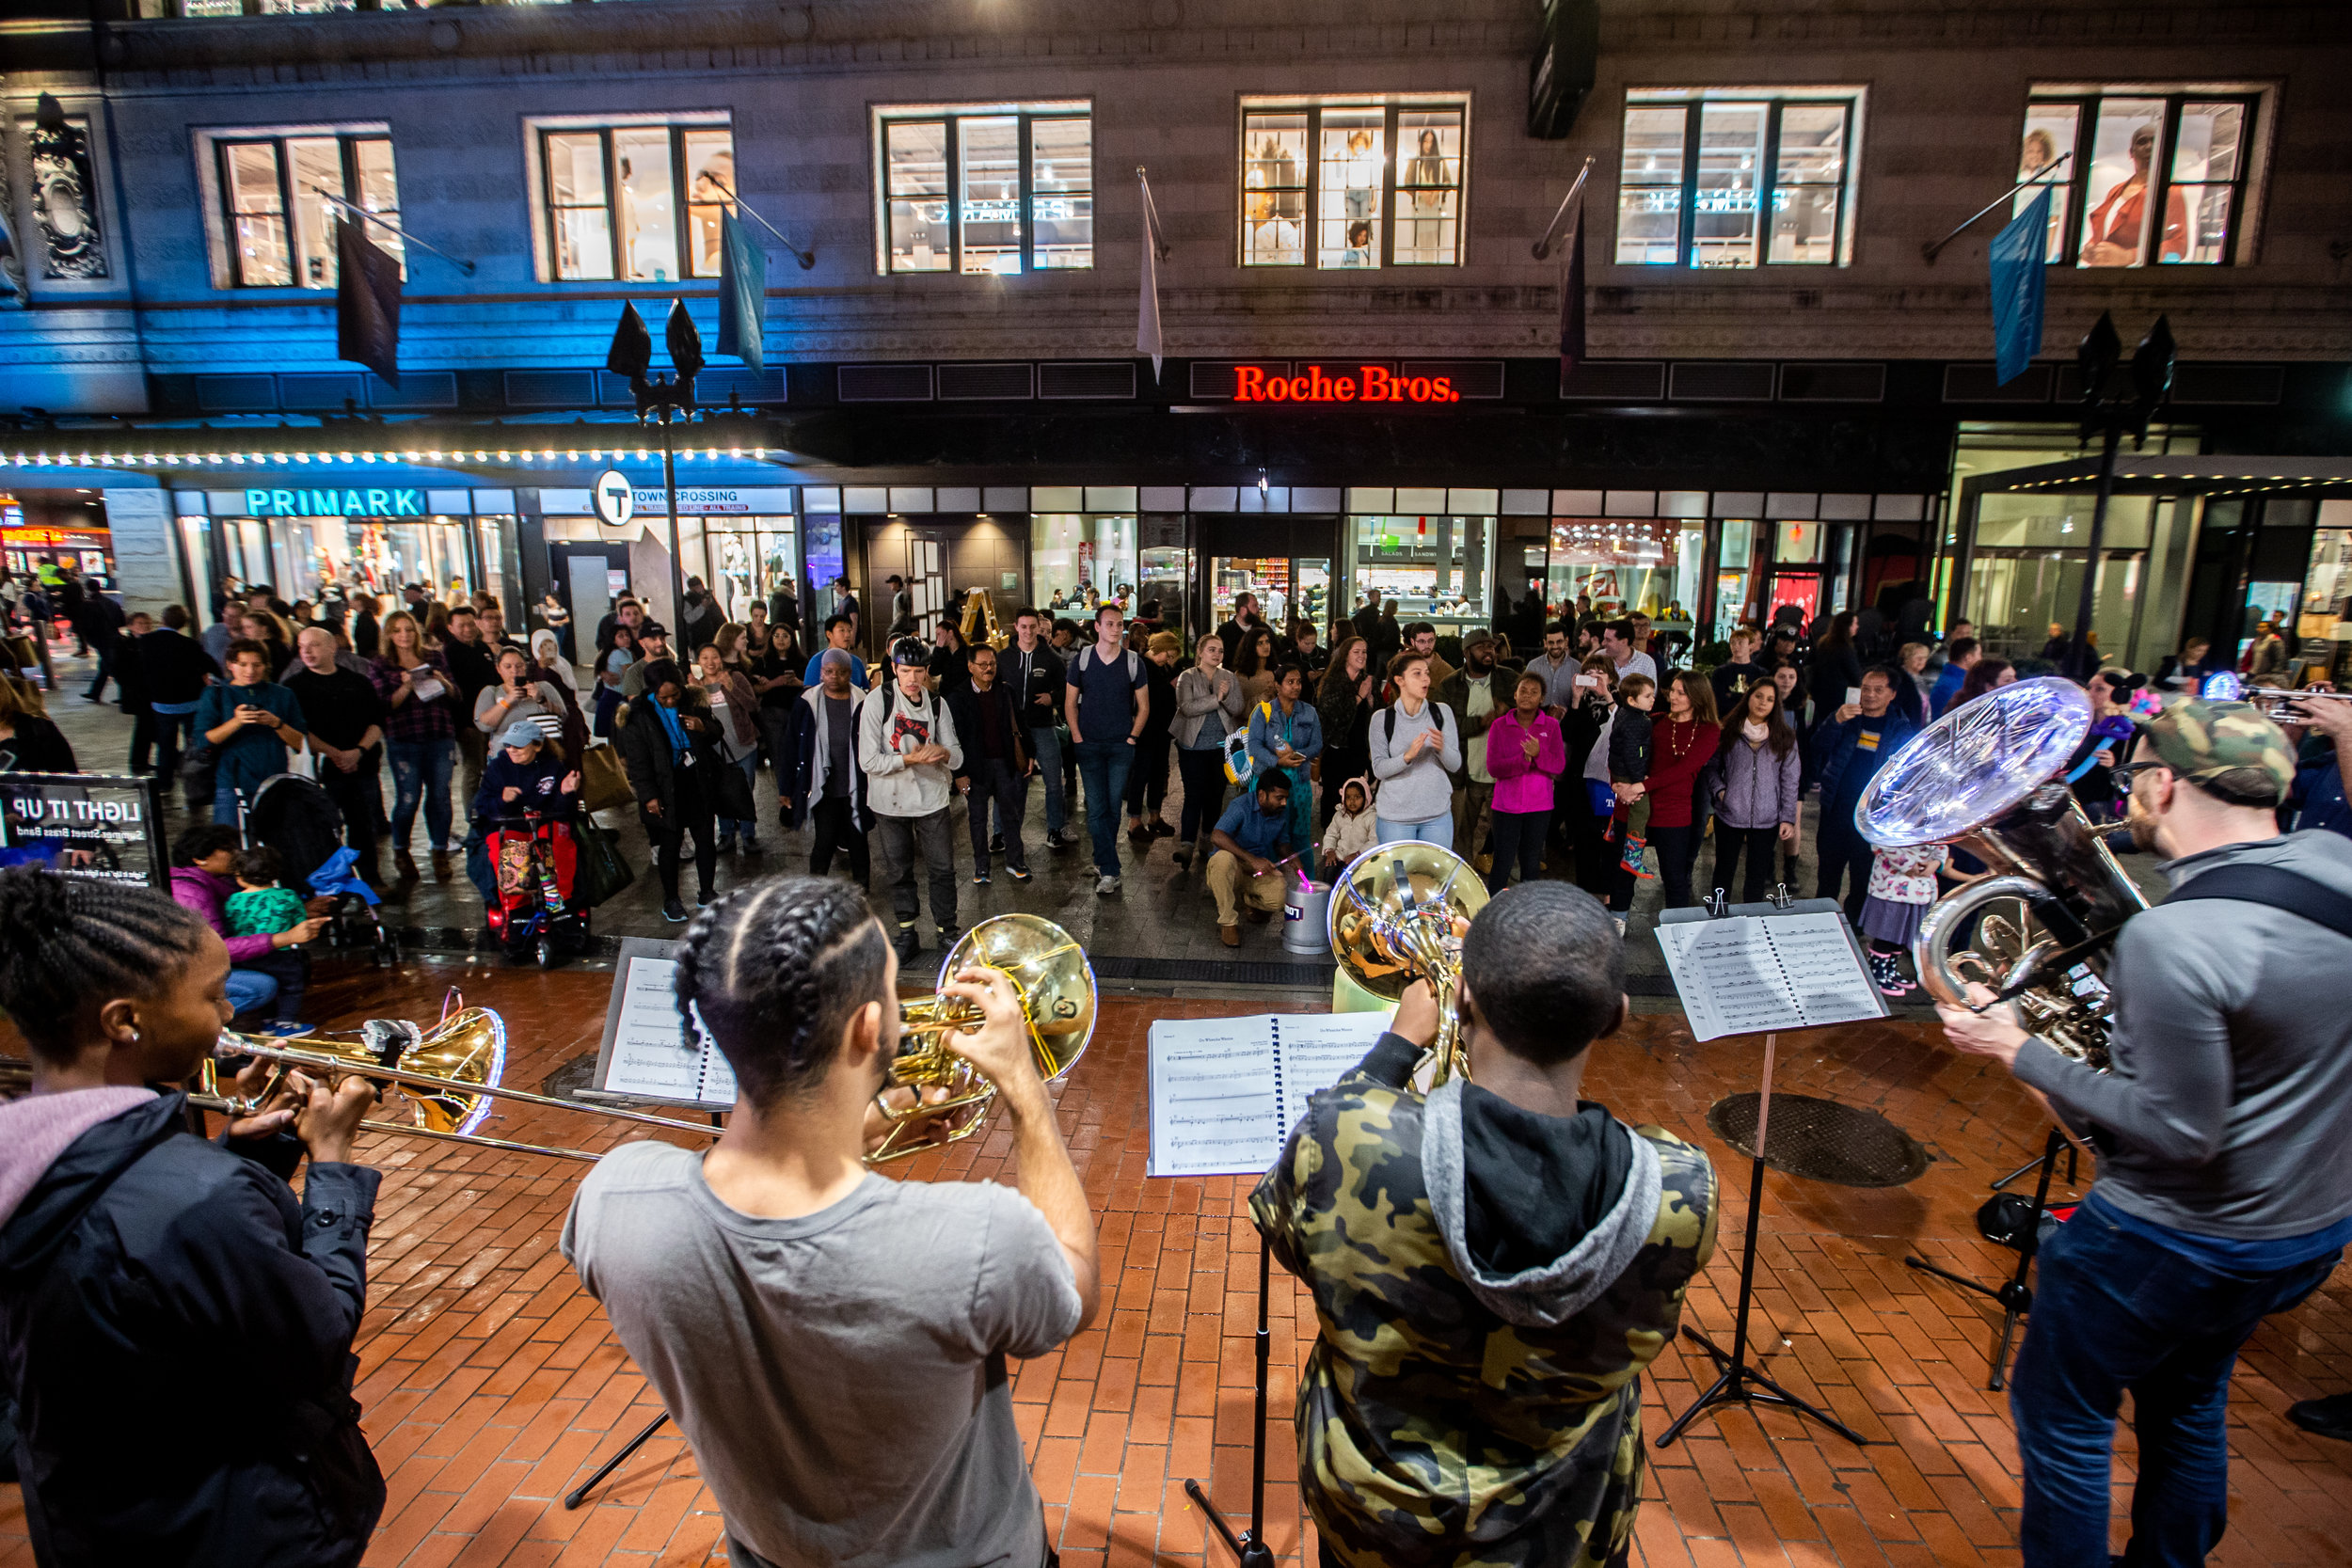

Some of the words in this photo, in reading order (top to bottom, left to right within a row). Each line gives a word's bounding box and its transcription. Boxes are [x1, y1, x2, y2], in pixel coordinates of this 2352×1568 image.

[1234, 366, 1356, 402] Roche
[1359, 366, 1459, 402] Bros.
[246, 489, 420, 516] PRIMARK
[606, 487, 628, 517] T
